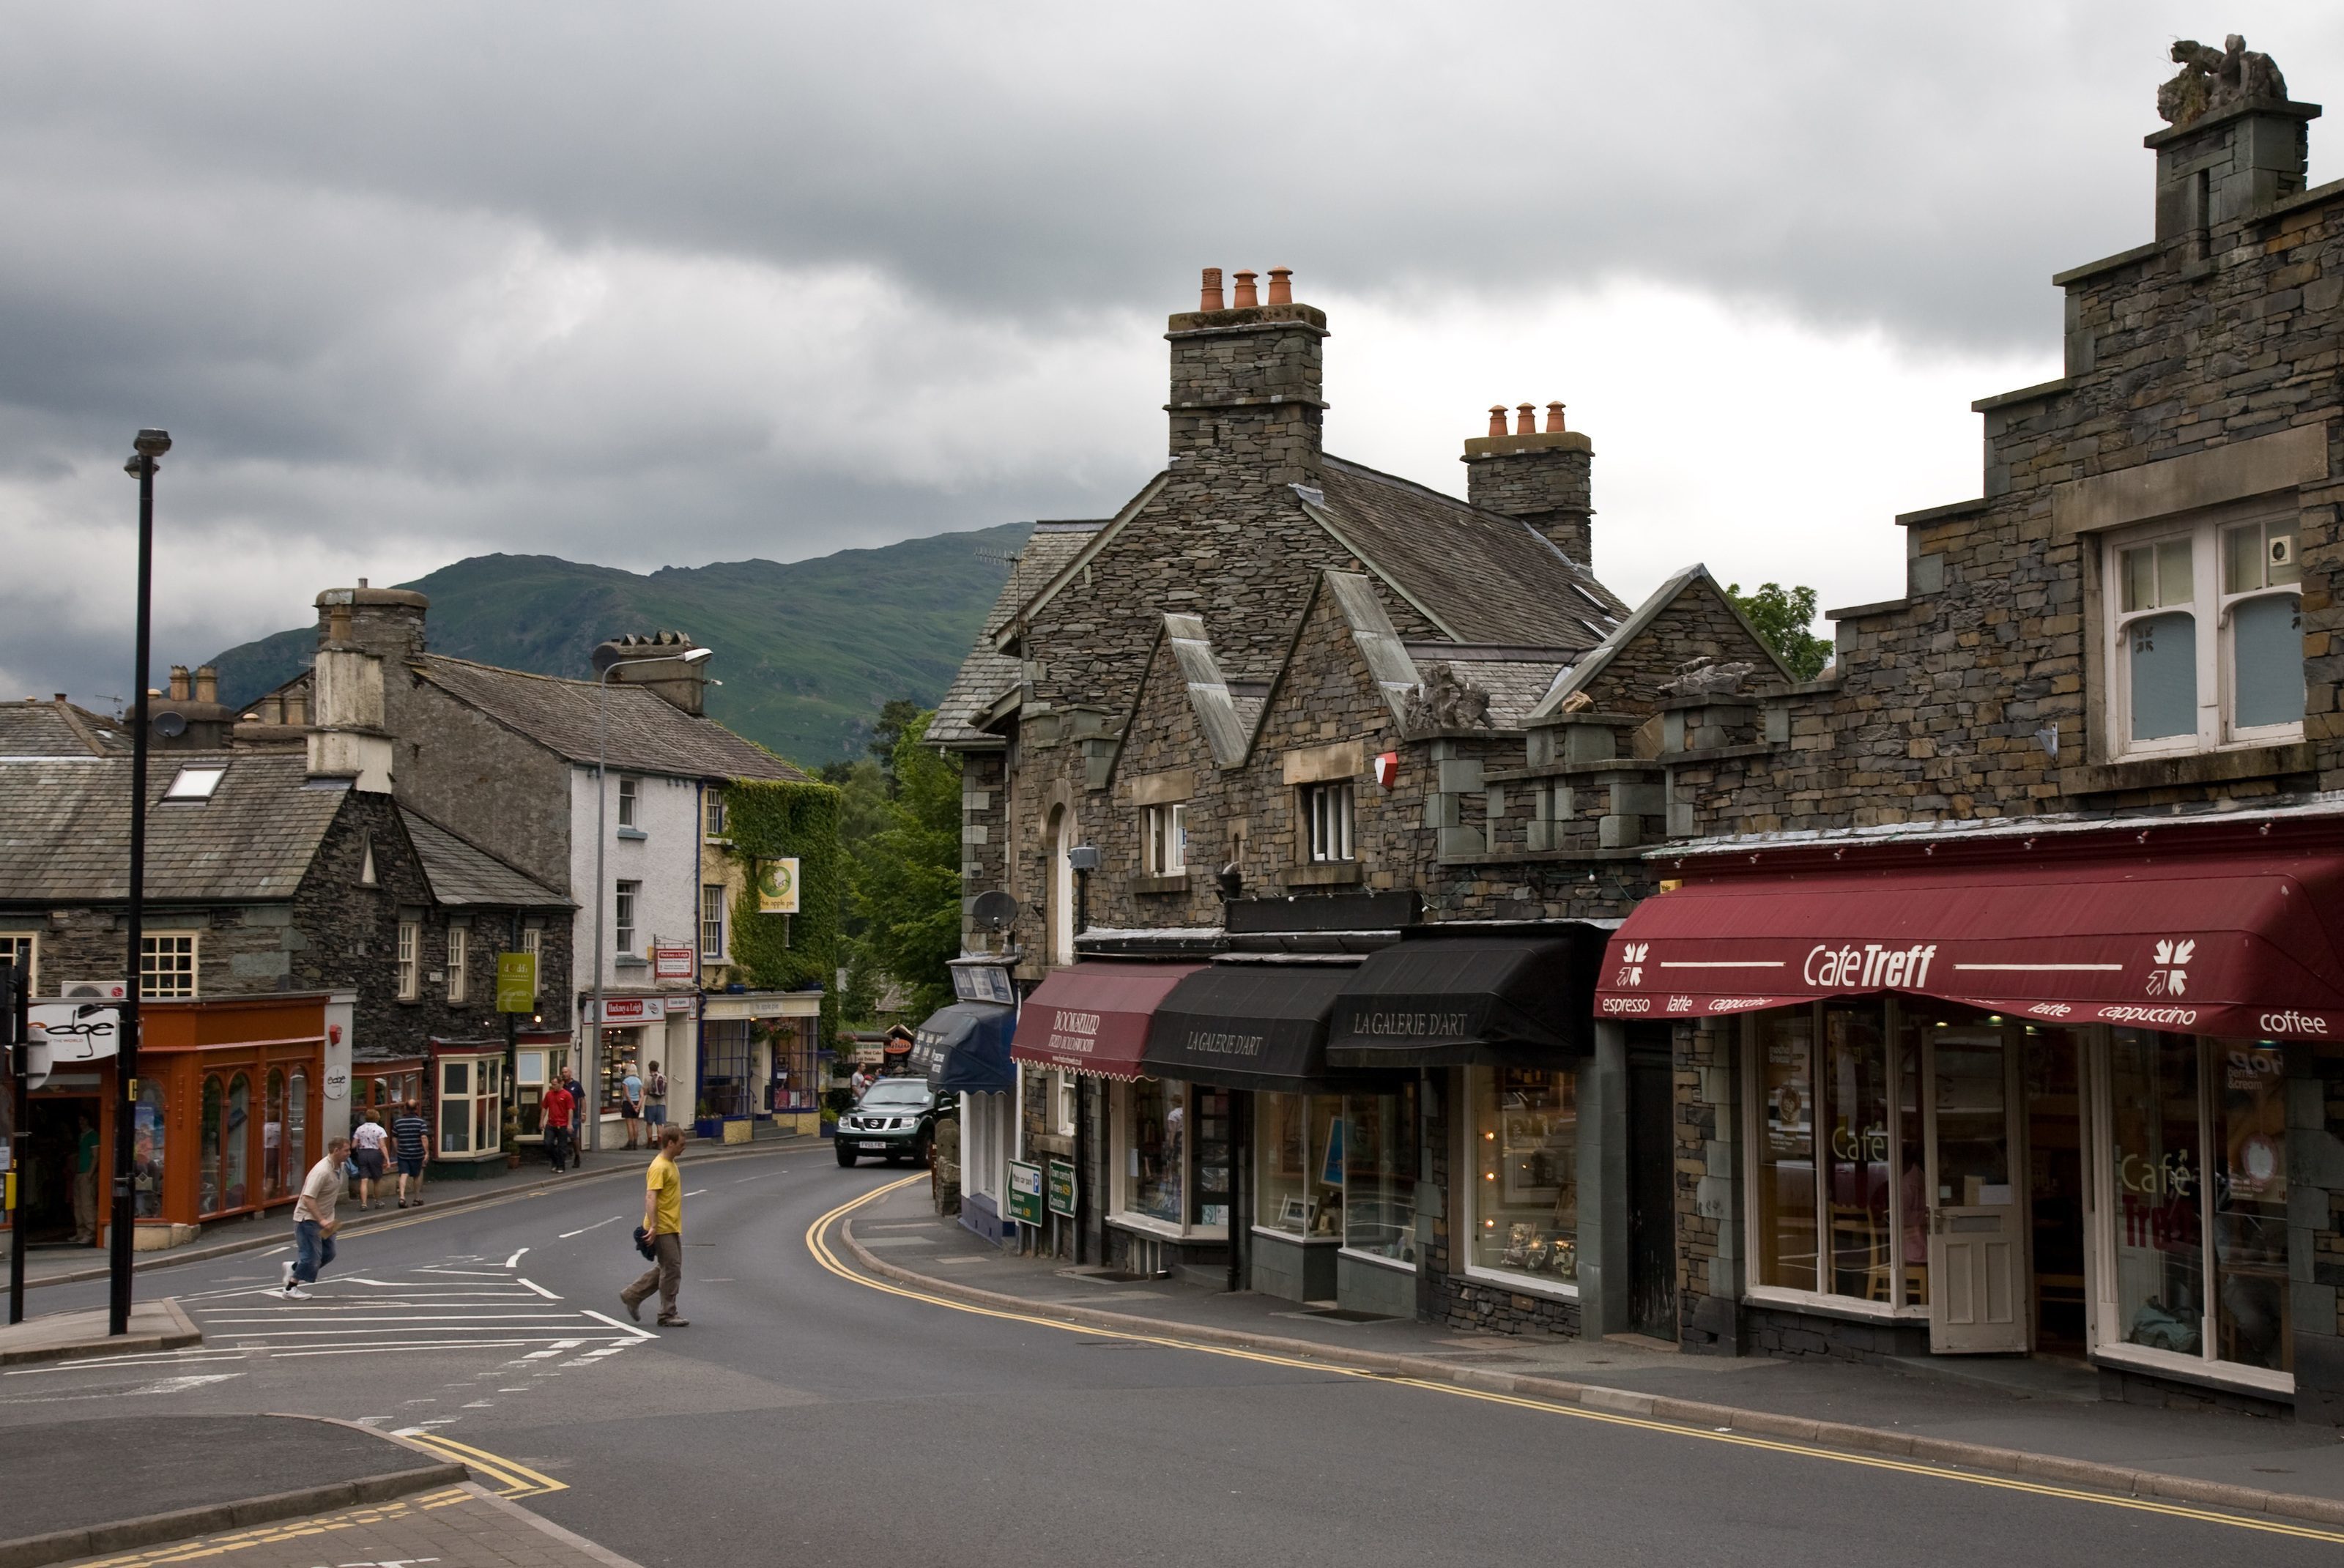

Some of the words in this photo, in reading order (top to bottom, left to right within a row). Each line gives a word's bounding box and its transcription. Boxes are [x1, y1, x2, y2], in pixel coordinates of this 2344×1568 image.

[608, 1003, 626, 1014] Hackney
[630, 1003, 642, 1014] Leigh
[1602, 997, 1650, 1014] espresso
[1666, 995, 1693, 1012] latte
[2028, 1003, 2072, 1017] latte
[2097, 1006, 2197, 1025] cappuccino
[1053, 1011, 1100, 1035] BOOKSELLER
[1354, 1013, 1370, 1034] LA
[1371, 1013, 1426, 1036] GALERIE
[1428, 1014, 1468, 1036] D'ART
[2260, 1011, 2328, 1034] coffee
[1187, 1031, 1198, 1049] LA
[1198, 1032, 1236, 1054] GALERIE
[1234, 1036, 1263, 1055] D'ART
[1050, 1166, 1059, 1178] Town
[1059, 1170, 1071, 1182] centre
